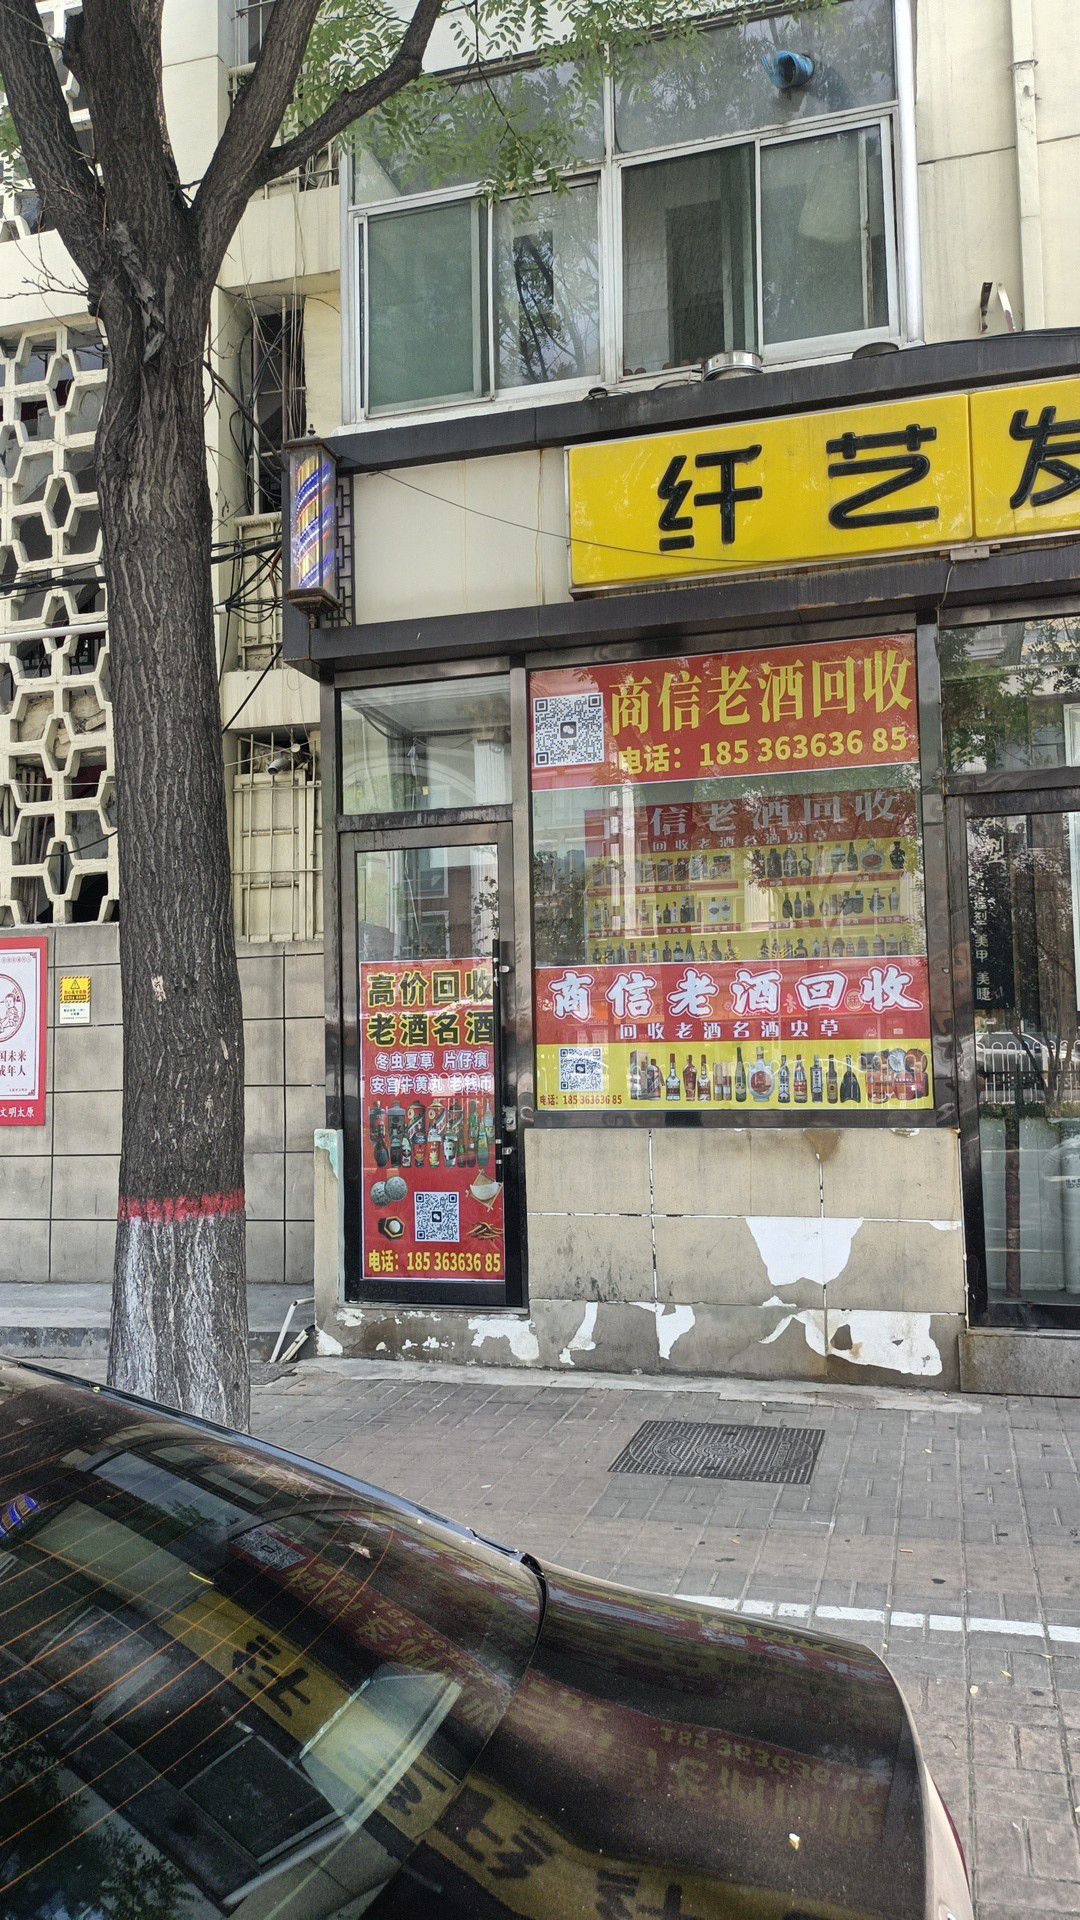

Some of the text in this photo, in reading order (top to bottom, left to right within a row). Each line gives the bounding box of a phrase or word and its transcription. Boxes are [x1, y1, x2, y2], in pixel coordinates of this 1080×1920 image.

[609, 649, 914, 737] 商信老酒回收
[699, 738, 749, 767] 185
[757, 729, 864, 764] 363636
[872, 725, 908, 753] 85
[604, 789, 898, 838] 信老酒回收
[975, 933, 989, 963] 美甲
[368, 969, 493, 1008] 高价回收
[548, 963, 923, 1022] 商信老酒回收
[367, 1010, 494, 1047] 老酒名酒
[619, 1019, 839, 1041] 回收老酒名酒虫草
[375, 1051, 435, 1072] 冬虫夏草
[370, 1072, 444, 1095] 安宫牛黄丸
[563, 1095, 578, 1105] 185
[580, 1095, 610, 1105] 363636
[612, 1094, 623, 1105] 85
[406, 1251, 431, 1271] 185
[434, 1251, 482, 1272] 363636
[485, 1252, 501, 1273] 85
